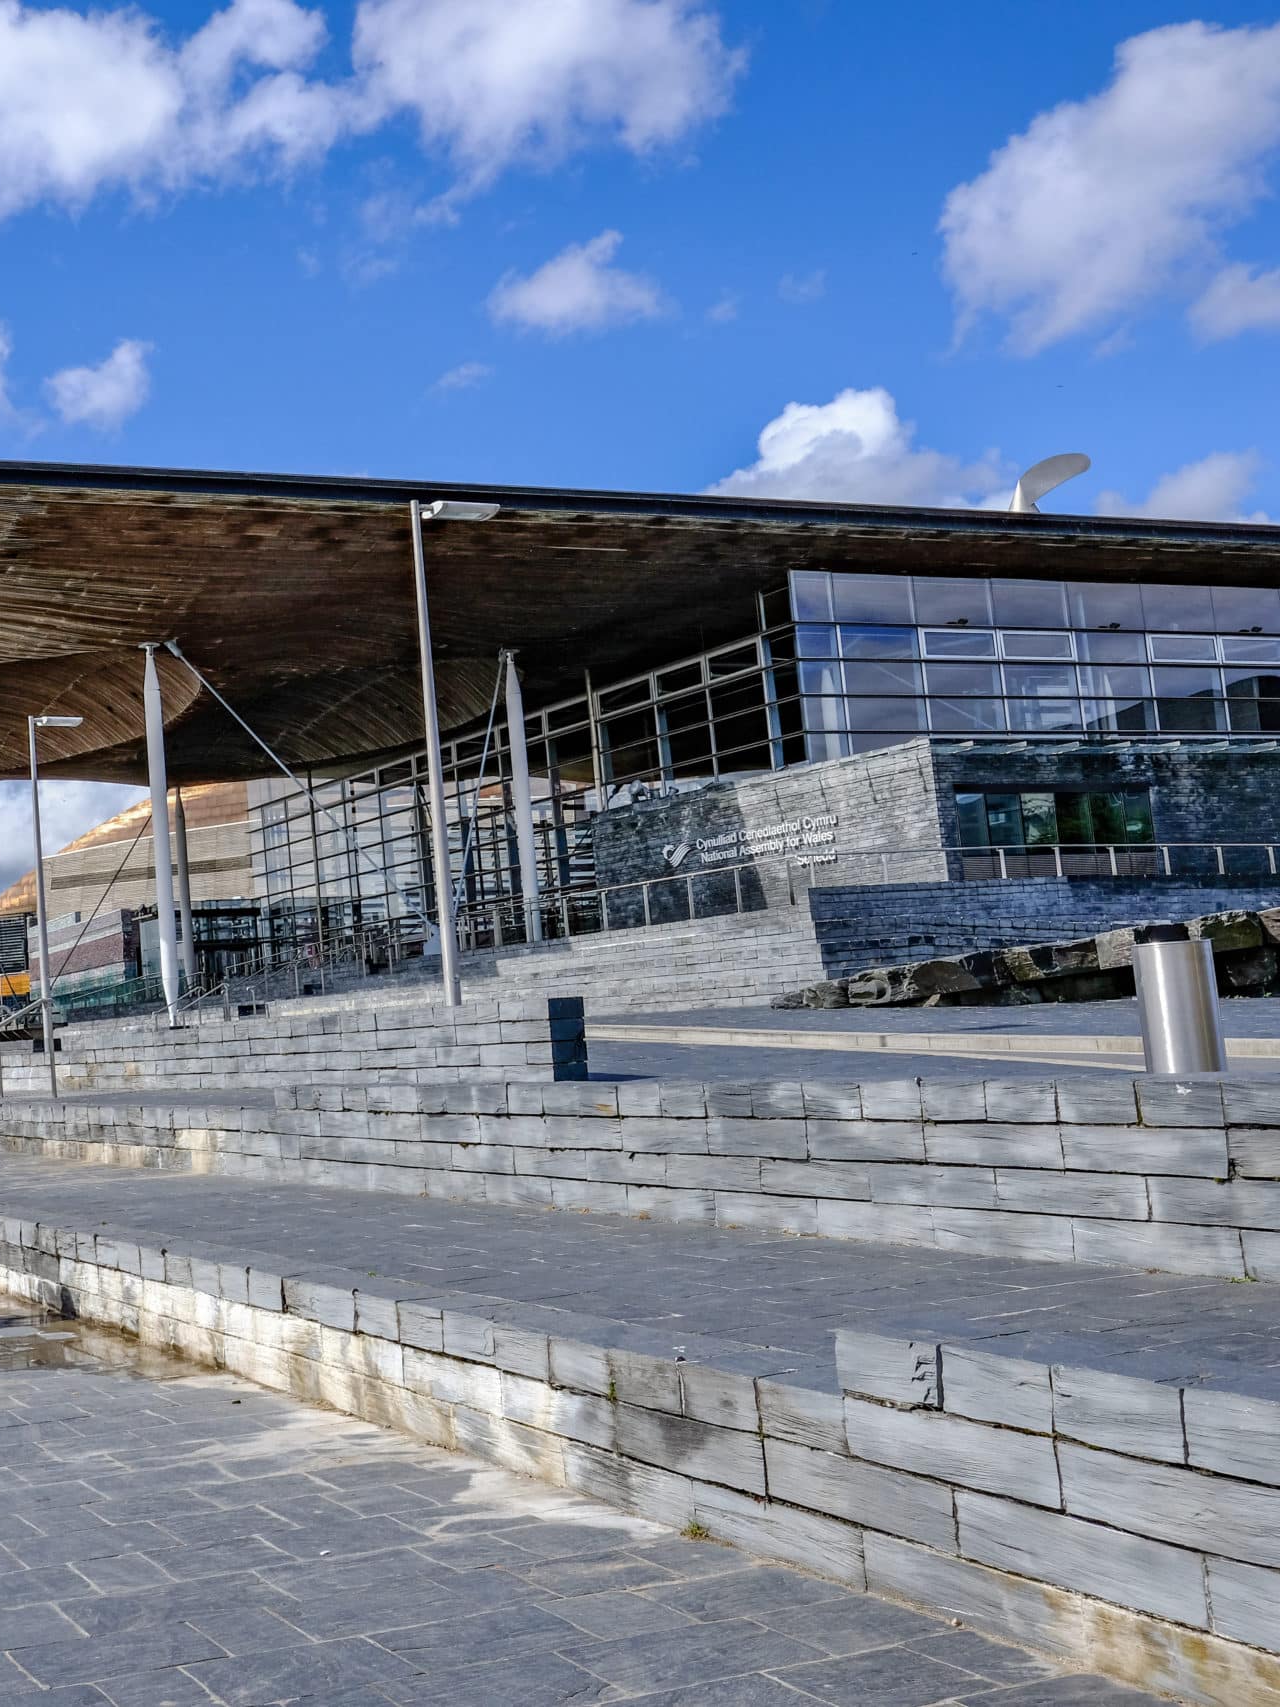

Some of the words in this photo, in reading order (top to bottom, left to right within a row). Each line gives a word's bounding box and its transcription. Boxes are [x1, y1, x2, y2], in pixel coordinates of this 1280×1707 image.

[696, 831, 737, 851] Cynulliad
[738, 819, 801, 842] Cenedlaethol
[802, 815, 838, 832] Cymru
[700, 846, 737, 863] National
[739, 838, 784, 857] Assembly
[786, 834, 800, 848] for
[802, 830, 834, 844] Wales
